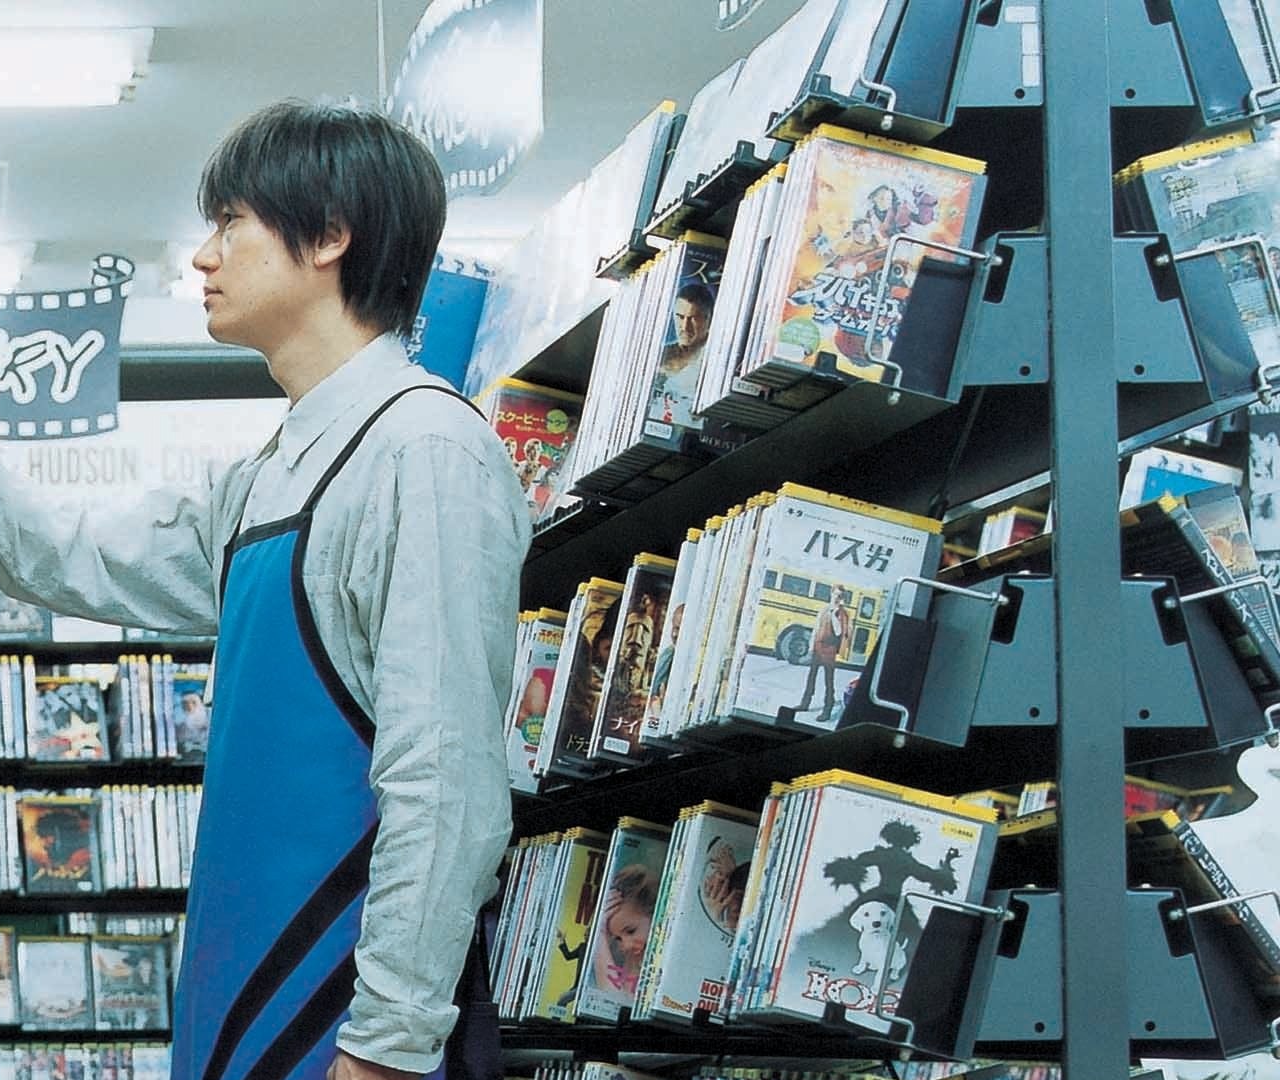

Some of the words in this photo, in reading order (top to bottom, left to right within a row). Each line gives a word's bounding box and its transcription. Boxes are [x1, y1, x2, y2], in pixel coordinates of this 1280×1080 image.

[27, 447, 138, 486] HUDSON
[804, 529, 894, 573] バス男
